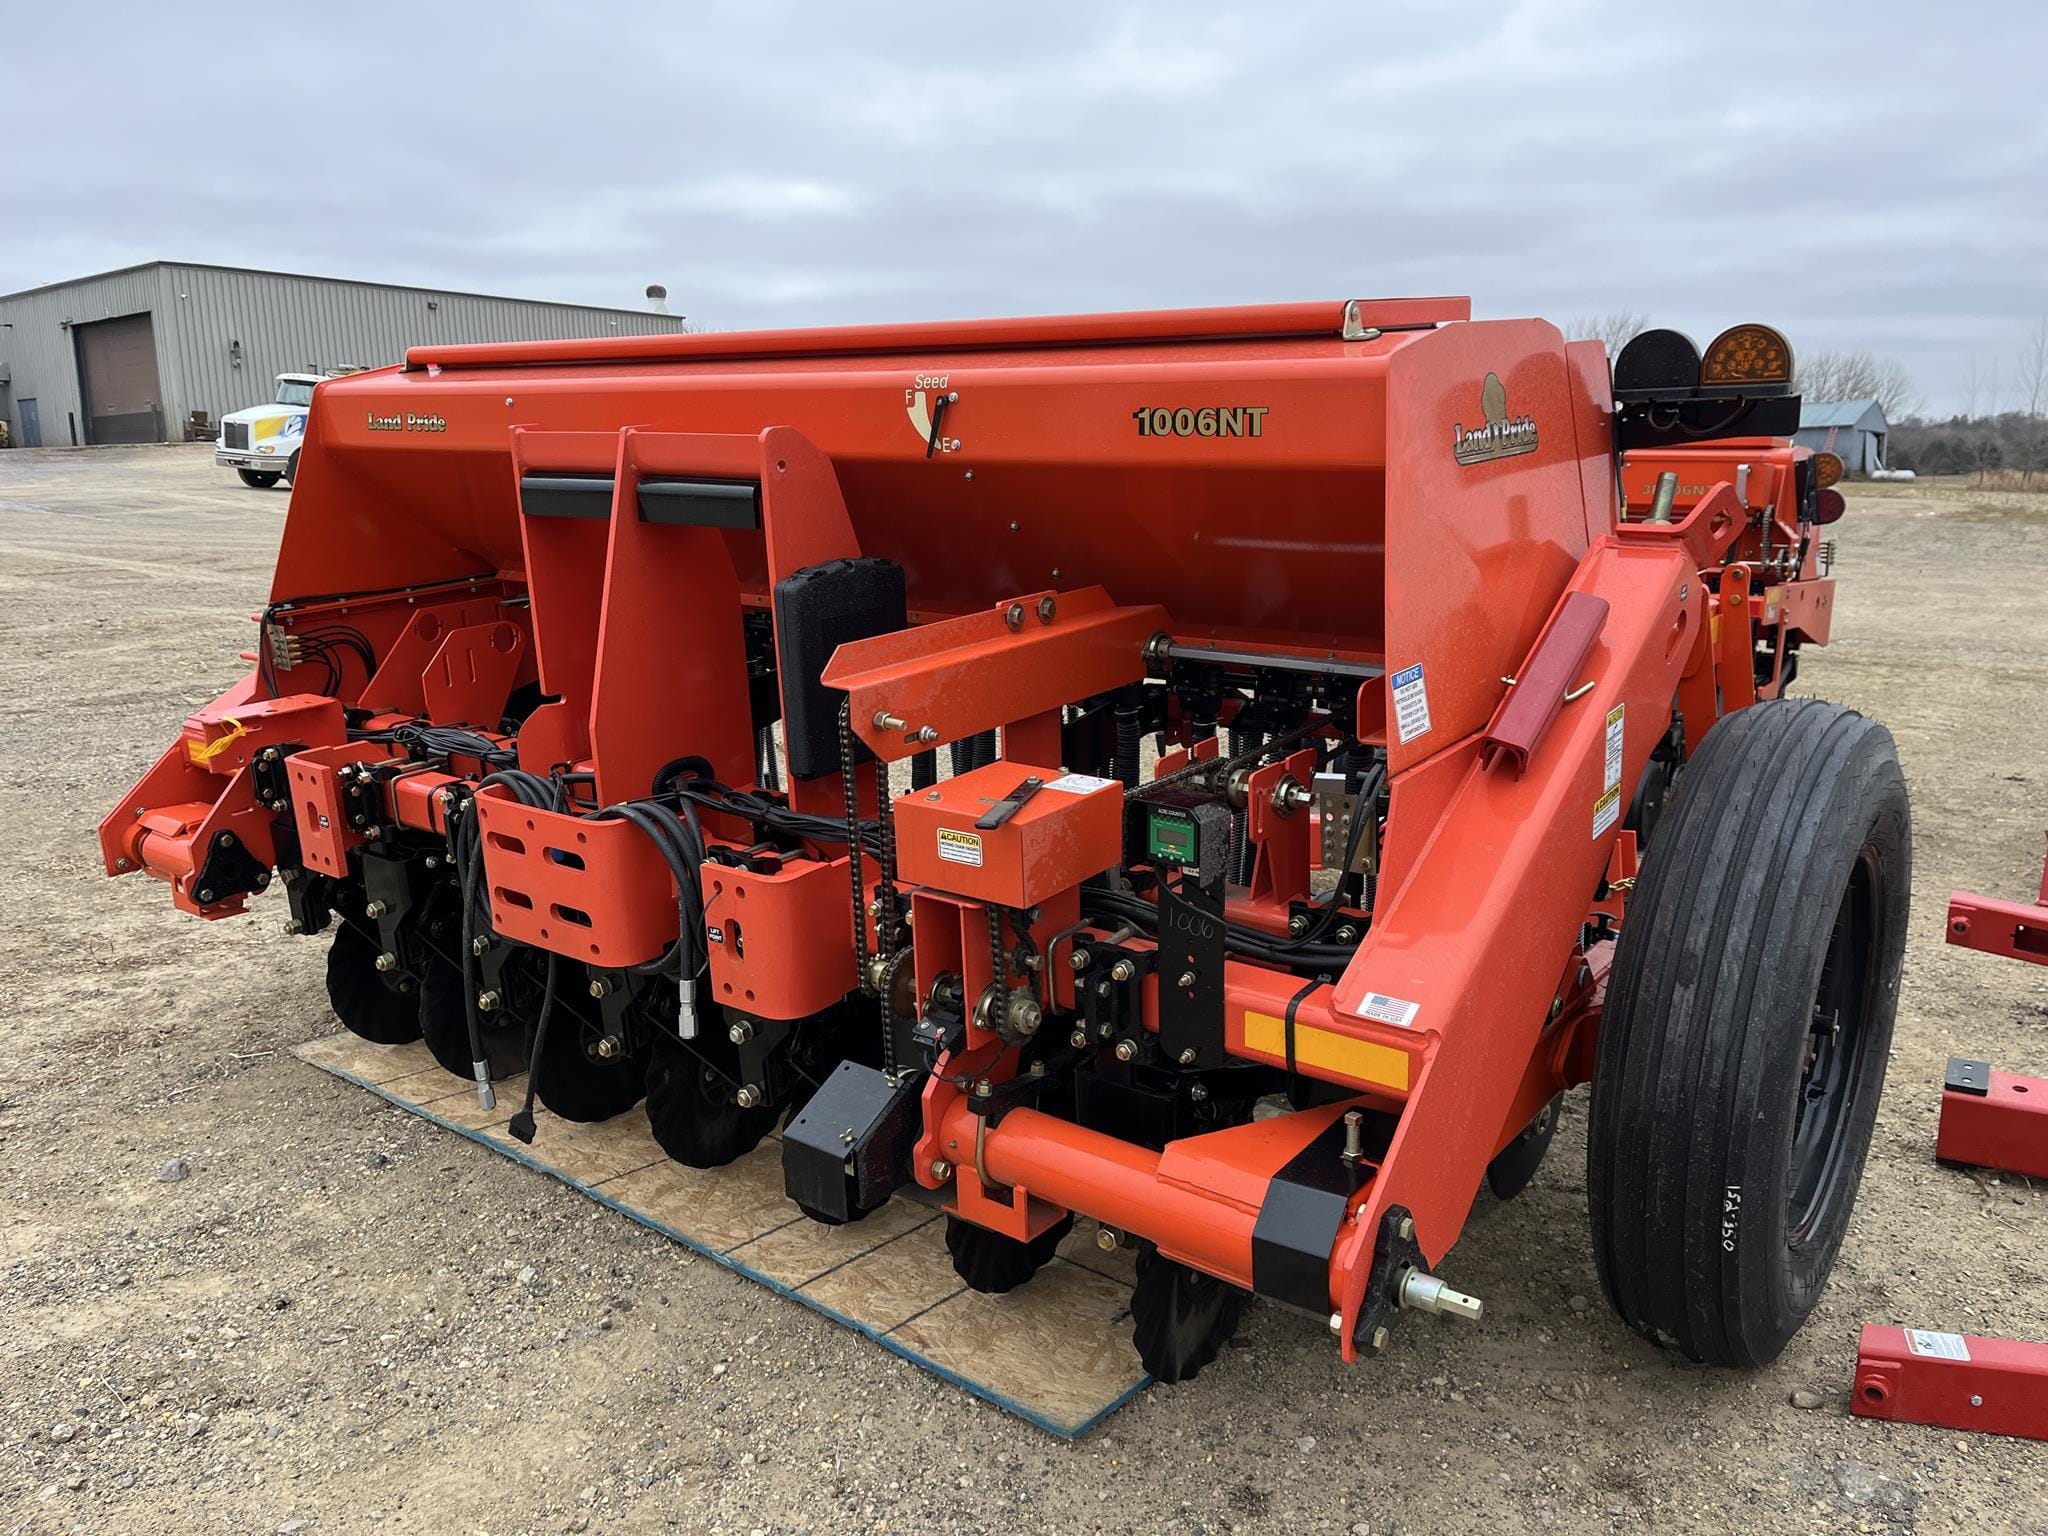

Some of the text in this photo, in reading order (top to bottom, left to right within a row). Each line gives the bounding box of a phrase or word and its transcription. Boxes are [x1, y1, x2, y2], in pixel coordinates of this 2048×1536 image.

[914, 373, 949, 389] Seed
[905, 389, 912, 405] F
[367, 411, 446, 432] Land Pride
[1133, 407, 1269, 437] 1006NT
[942, 437, 951, 453] E
[1454, 415, 1537, 455] Land Pride
[1396, 667, 1420, 687] NOTICE
[1599, 787, 1619, 808] CAUTION
[946, 833, 979, 846] CAUTION
[1170, 906, 1214, 939] 1006
